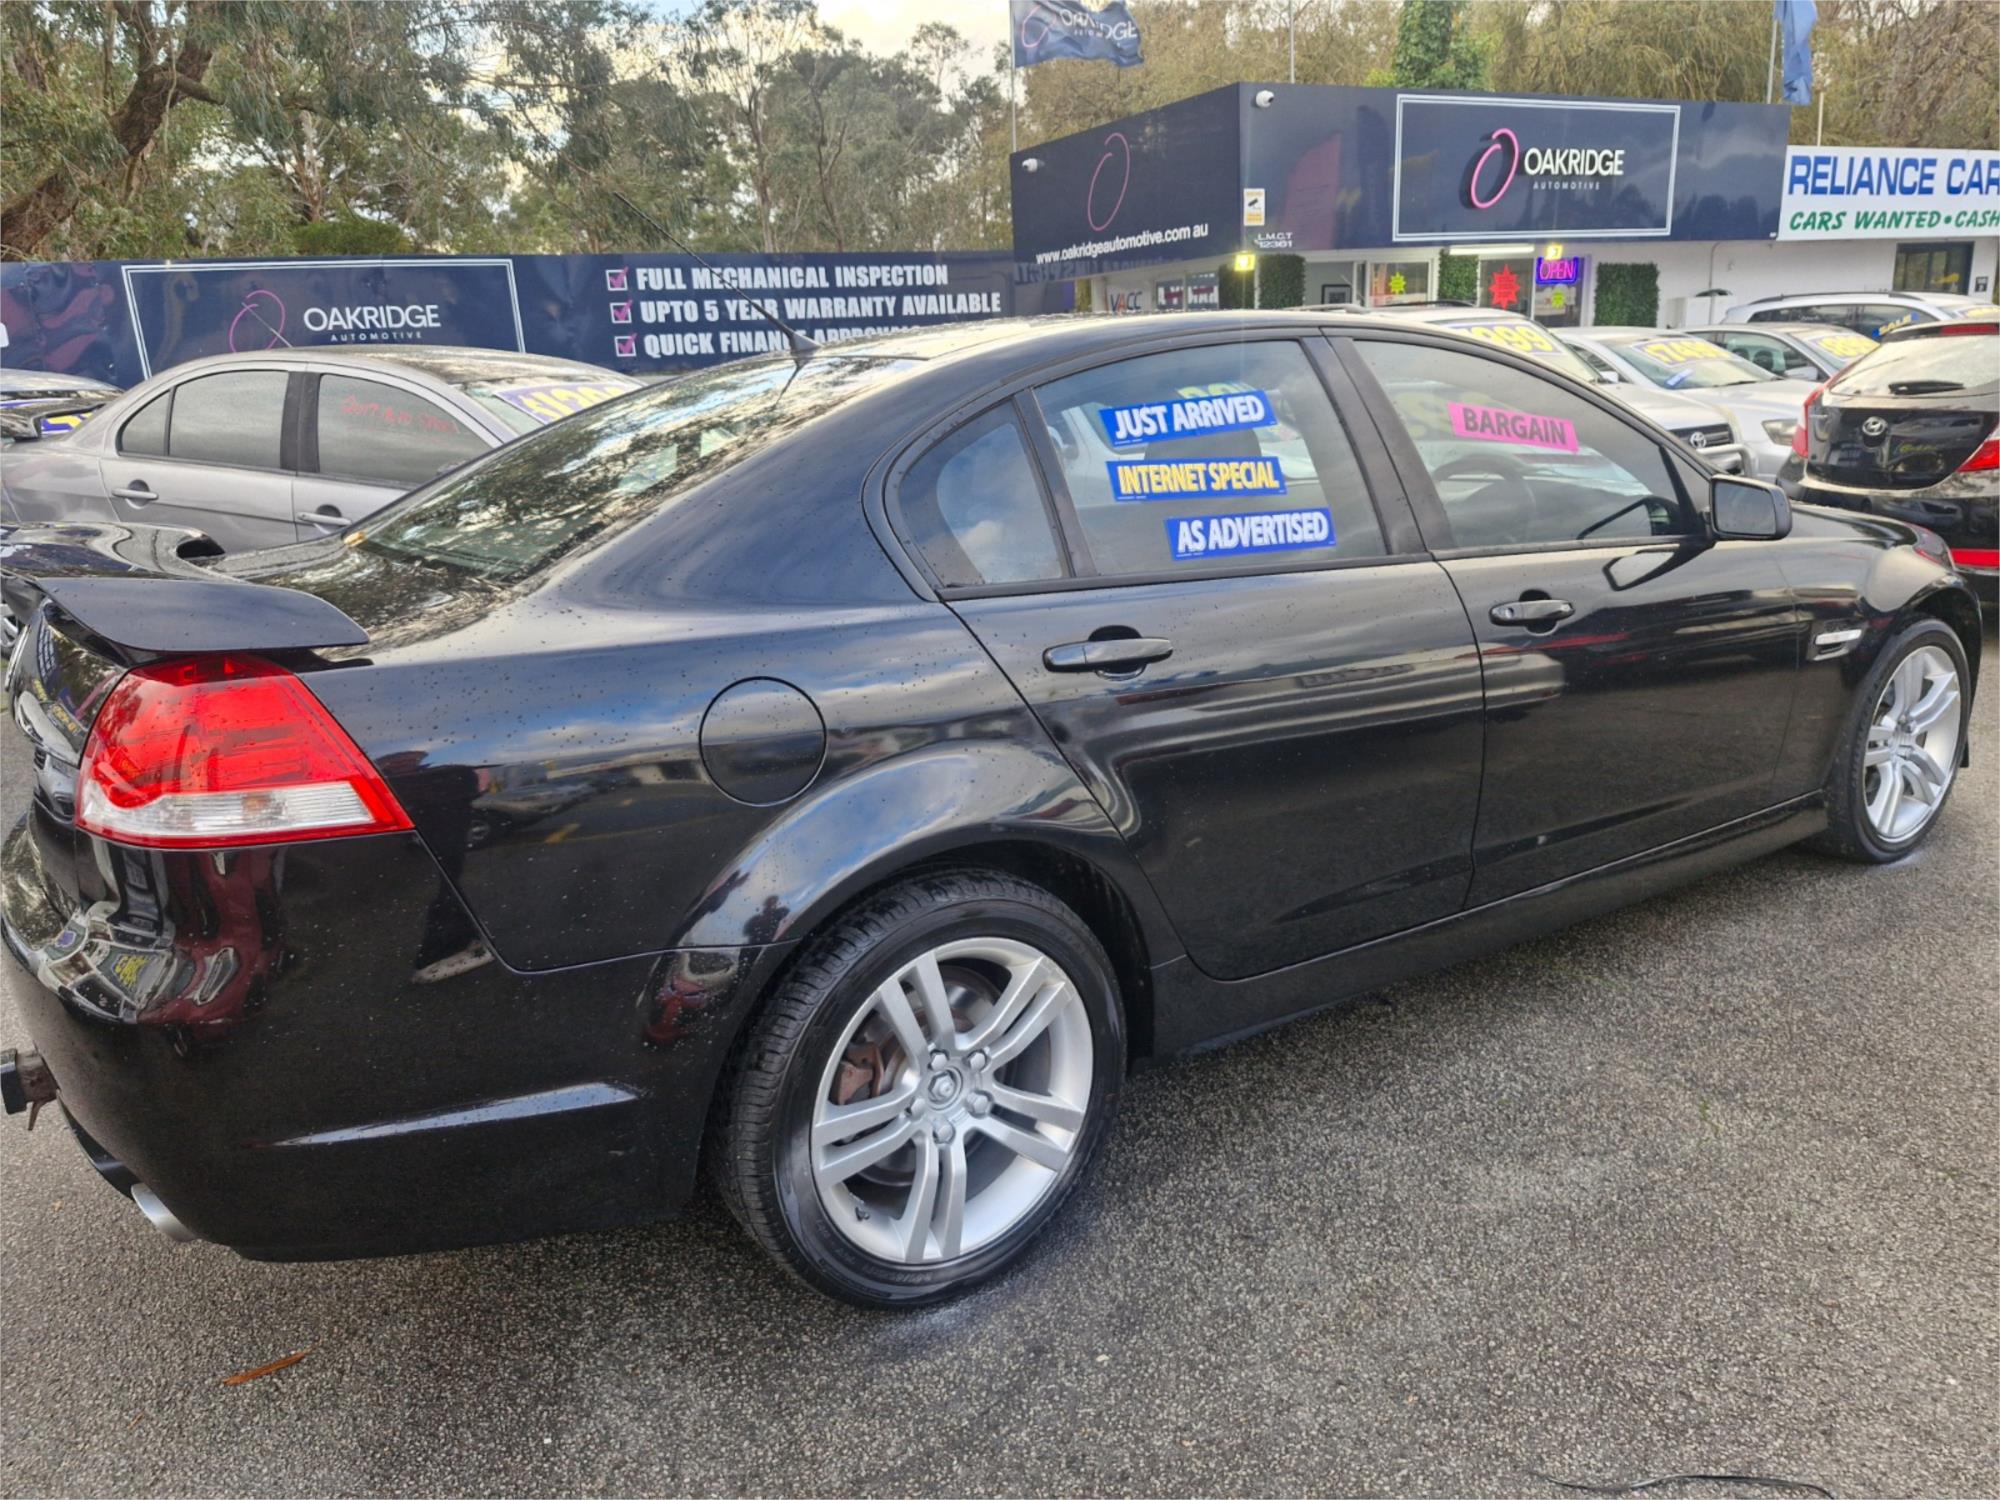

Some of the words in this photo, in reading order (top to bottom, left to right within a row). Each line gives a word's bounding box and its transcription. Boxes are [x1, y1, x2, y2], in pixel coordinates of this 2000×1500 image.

[1524, 147, 1625, 176] OAKRIDGE
[1788, 155, 1938, 196] RELIANCE
[1532, 181, 1600, 191] AUTOMOTIVE
[1789, 211, 1847, 231] CARS
[636, 267, 687, 291] FULL
[691, 266, 829, 290] MECHANICAL
[835, 264, 949, 288] INSPECTION
[1540, 259, 1574, 280] OPEN
[303, 304, 441, 332] OAKRIDGE
[640, 300, 699, 324] UPTO
[704, 300, 719, 323] 5
[724, 298, 779, 322] YEAR
[784, 296, 896, 320] WARRANTY
[902, 292, 1001, 317] AVAILABLE
[330, 331, 422, 342] AUTOMOTIVE
[643, 331, 715, 359] QUICK
[1114, 405, 1169, 440] JUST
[1173, 395, 1265, 432] ARRIVED
[1463, 407, 1567, 446] BARGAIN
[1117, 462, 1207, 495] INTERNET
[1208, 461, 1280, 492] SPECIAL
[1177, 519, 1207, 554] AS
[1208, 511, 1330, 550] ADVERTISED
